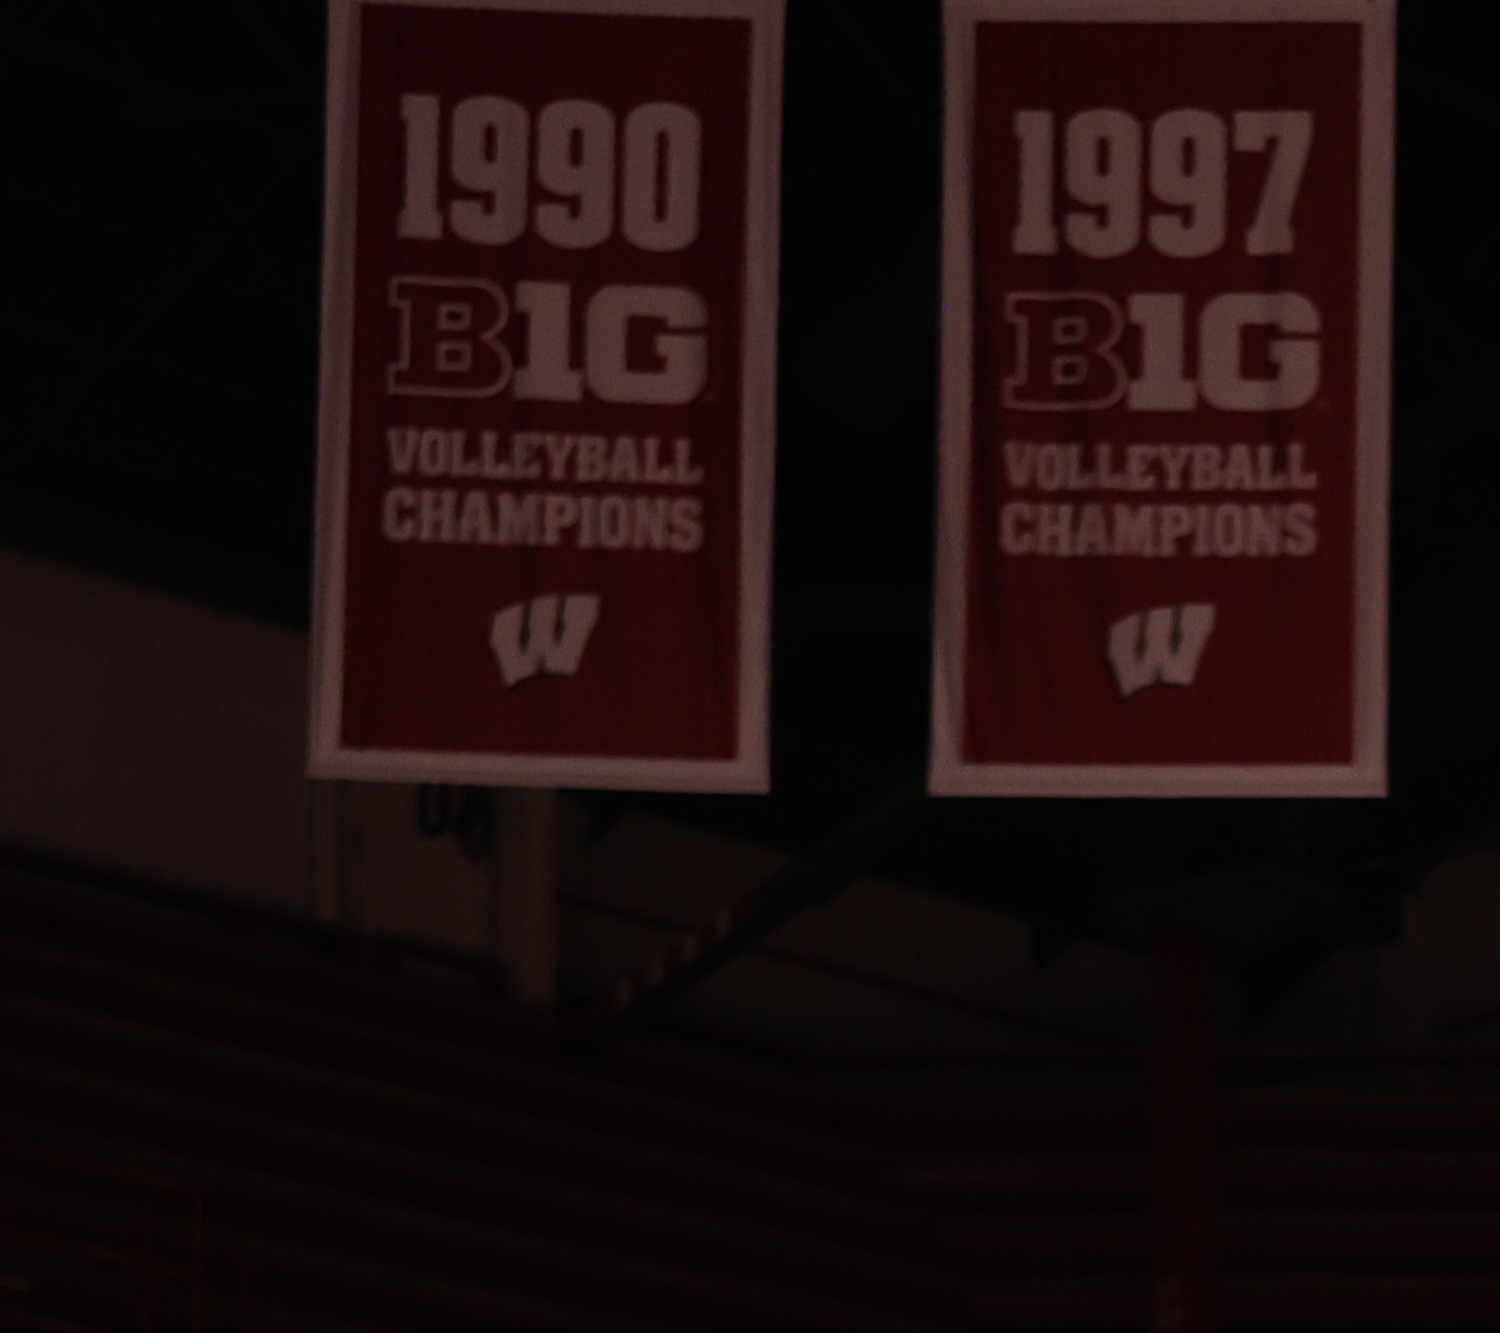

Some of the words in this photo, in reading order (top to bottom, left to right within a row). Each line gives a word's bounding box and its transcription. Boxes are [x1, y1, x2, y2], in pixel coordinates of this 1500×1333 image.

[399, 93, 701, 251] 1990
[1010, 107, 1314, 260] 1997
[385, 427, 704, 485] VOLLEYBALL
[1003, 443, 1317, 492] VOLLEYBALL
[381, 492, 703, 552] CHAMPIONS
[999, 500, 1317, 559] CHAMPIONS
